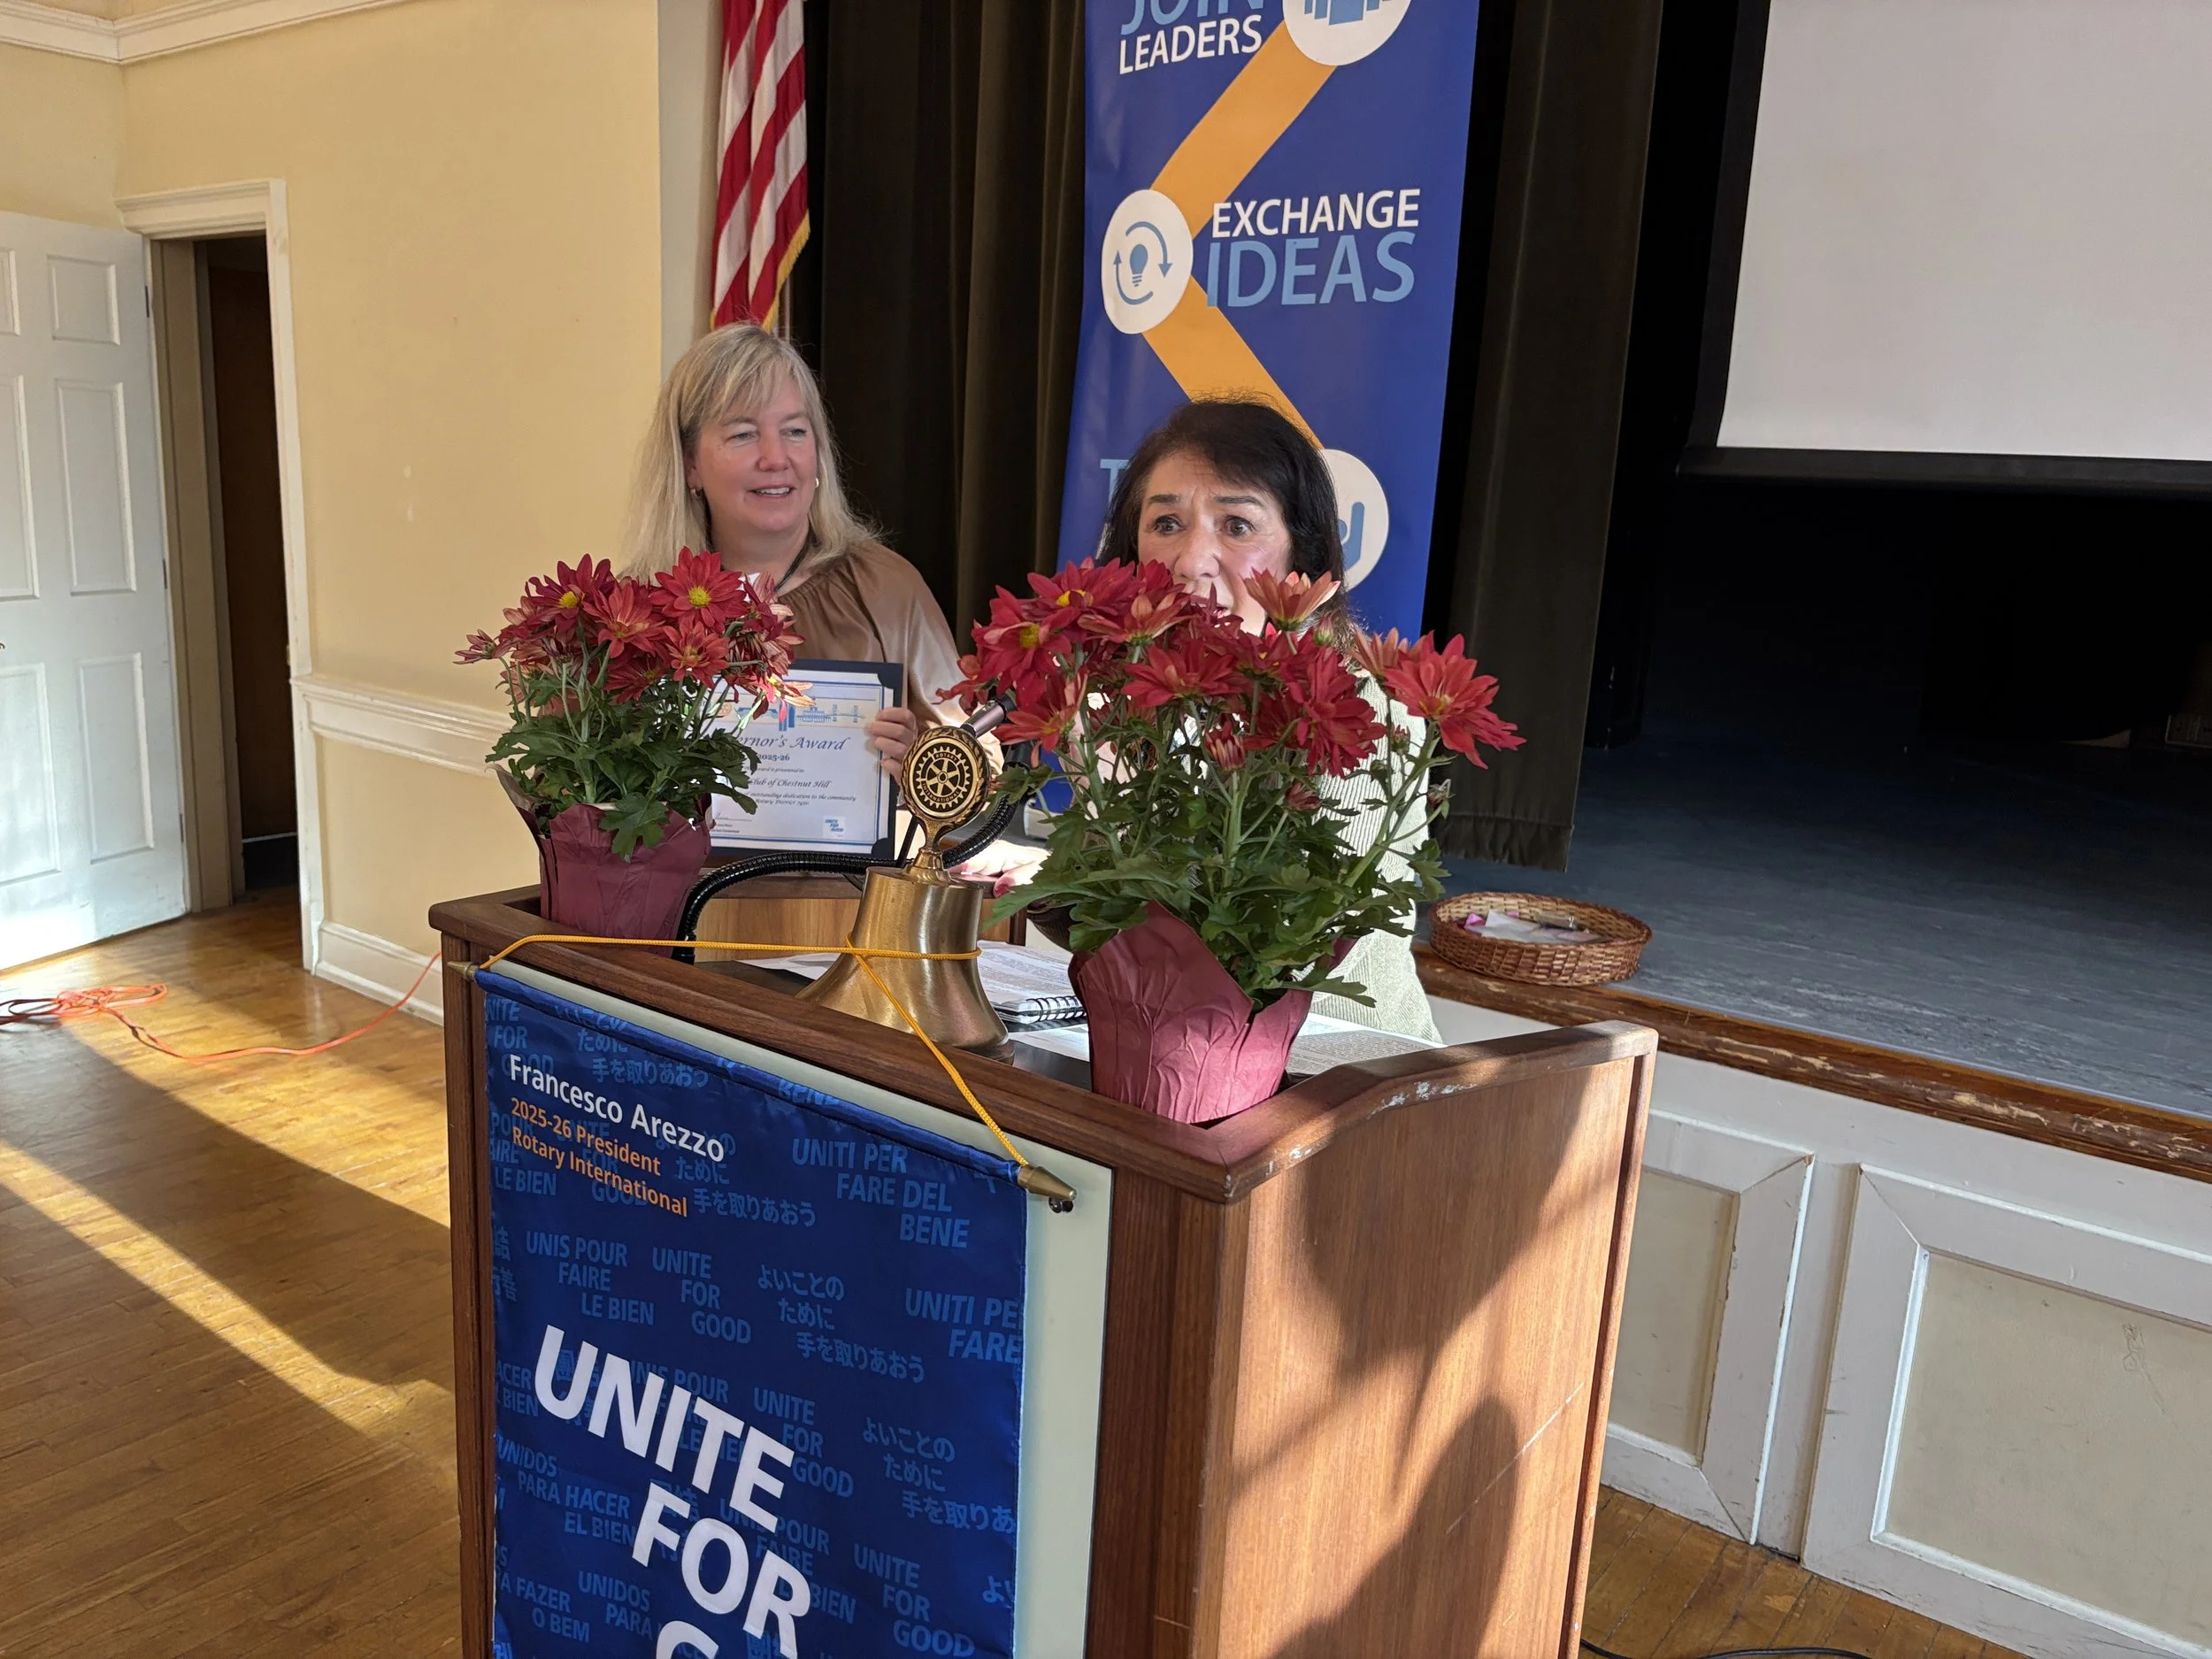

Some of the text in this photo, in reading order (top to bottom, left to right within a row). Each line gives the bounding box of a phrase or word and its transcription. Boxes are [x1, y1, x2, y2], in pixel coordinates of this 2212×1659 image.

[1119, 14, 1263, 74] LEADERS
[1211, 188, 1421, 238] EXCHANGE
[1206, 232, 1416, 307] IDEAS
[789, 736, 850, 750] Award
[777, 779, 811, 787] Chestnut
[812, 780, 832, 788] Hill
[485, 998, 520, 1022] NITE
[494, 1025, 527, 1049] FOR
[510, 1054, 623, 1124] Francesco
[631, 1103, 725, 1163] Arezzo
[489, 1139, 519, 1164] AIRE
[511, 1097, 572, 1139] 2025-26
[576, 1125, 662, 1176] President
[792, 1138, 908, 1174] UNITI PER
[495, 1166, 557, 1196] LE BIEN
[512, 1125, 687, 1217] Rotary International
[694, 1187, 816, 1227] 手を取りあおう
[836, 1172, 895, 1206] FARE
[902, 1179, 953, 1213] DEL
[526, 1231, 571, 1259] UNIS
[575, 1237, 628, 1268] POUR
[899, 1213, 971, 1248] BENE
[558, 1262, 611, 1292] FAIRE
[652, 1247, 712, 1279] UNITE
[757, 1263, 845, 1301] よいことの
[580, 1292, 655, 1325] LE BIEN
[680, 1279, 721, 1310] FOR
[778, 1297, 835, 1331] ために
[905, 1287, 1021, 1329] UNITI PE
[691, 1310, 751, 1345] GOOD
[796, 1331, 925, 1383] 手を取りあおう
[754, 1386, 817, 1426] UNITE
[534, 1324, 795, 1533] UNITE
[781, 1422, 825, 1459] FOR
[862, 1416, 956, 1463] よいことの
[793, 1456, 854, 1499] GOOD
[883, 1452, 947, 1493] ために
[518, 1470, 561, 1504] PARA
[565, 1485, 631, 1520] HACER
[902, 1489, 1018, 1535] 手を取りあ
[564, 1510, 588, 1536] EL
[632, 1481, 811, 1659] FOR
[854, 1543, 920, 1589] UNITE
[516, 1577, 572, 1614] FAZER
[578, 1571, 651, 1613] UNIDOS
[882, 1584, 931, 1623] FOR
[532, 1607, 592, 1644] O BEM
[604, 1601, 653, 1641] PARA
[893, 1619, 976, 1658] GOOD
